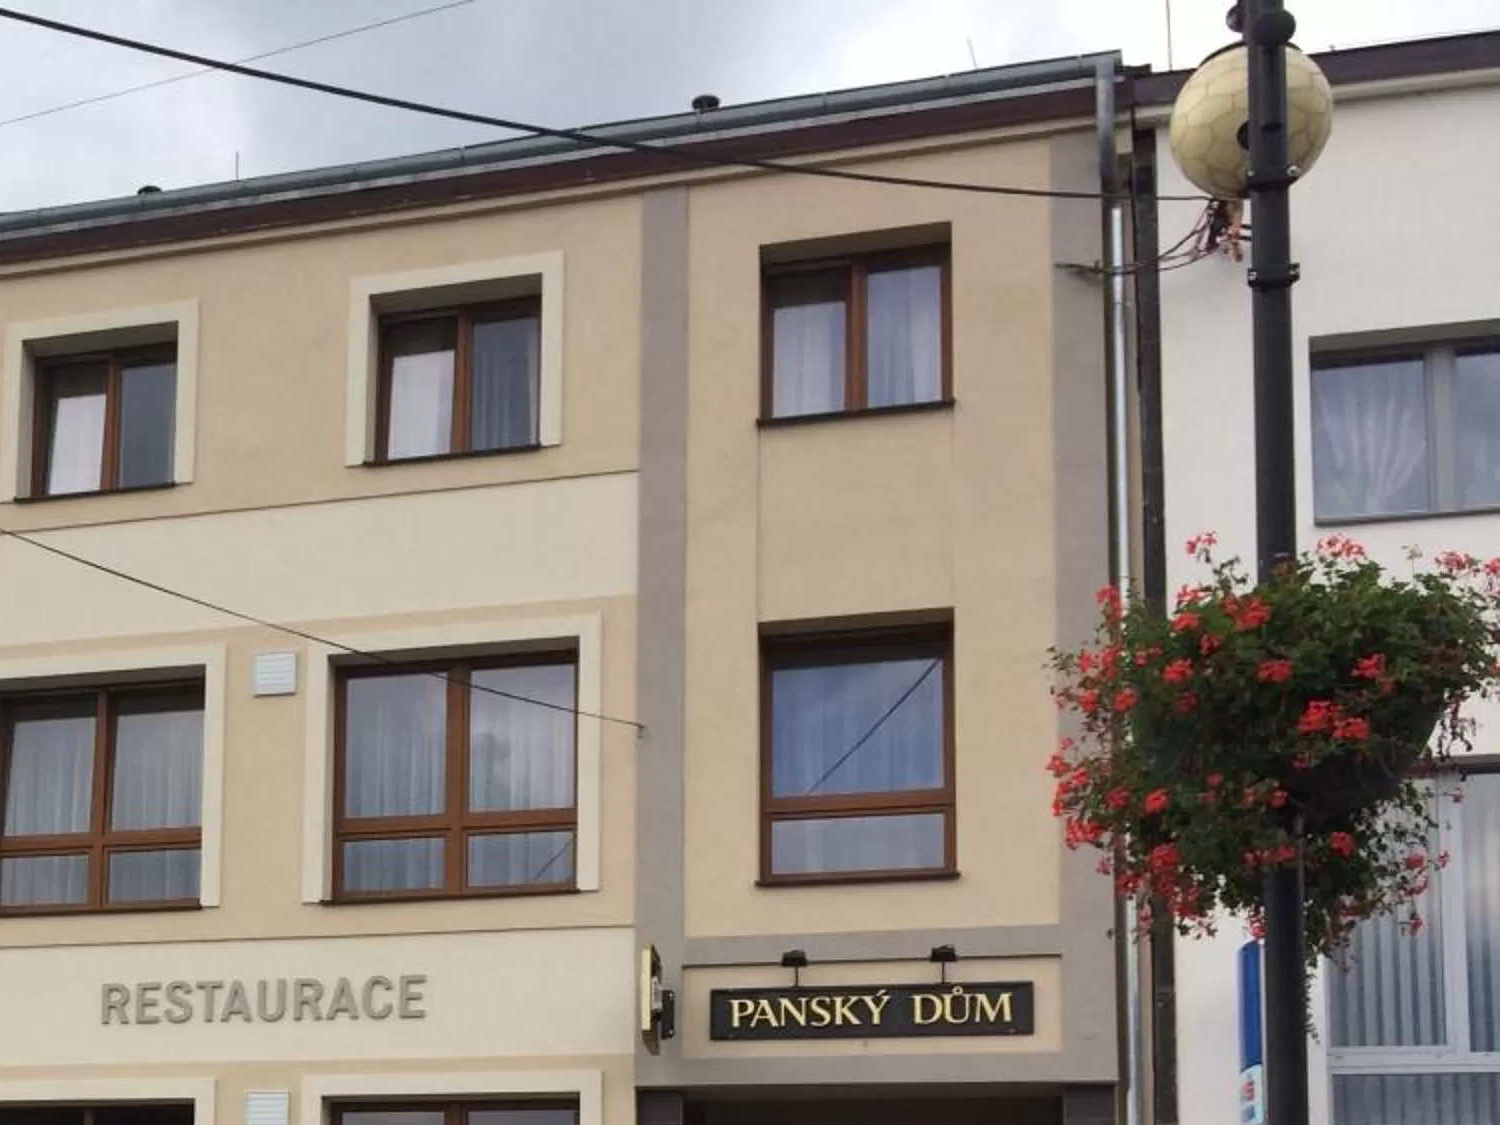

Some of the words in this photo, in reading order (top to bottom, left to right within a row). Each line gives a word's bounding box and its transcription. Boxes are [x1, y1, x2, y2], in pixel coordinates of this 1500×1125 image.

[100, 974, 428, 1025] RESTAURACE
[729, 988, 891, 1028] PANSKÝ
[912, 985, 1013, 1025] DŮM
